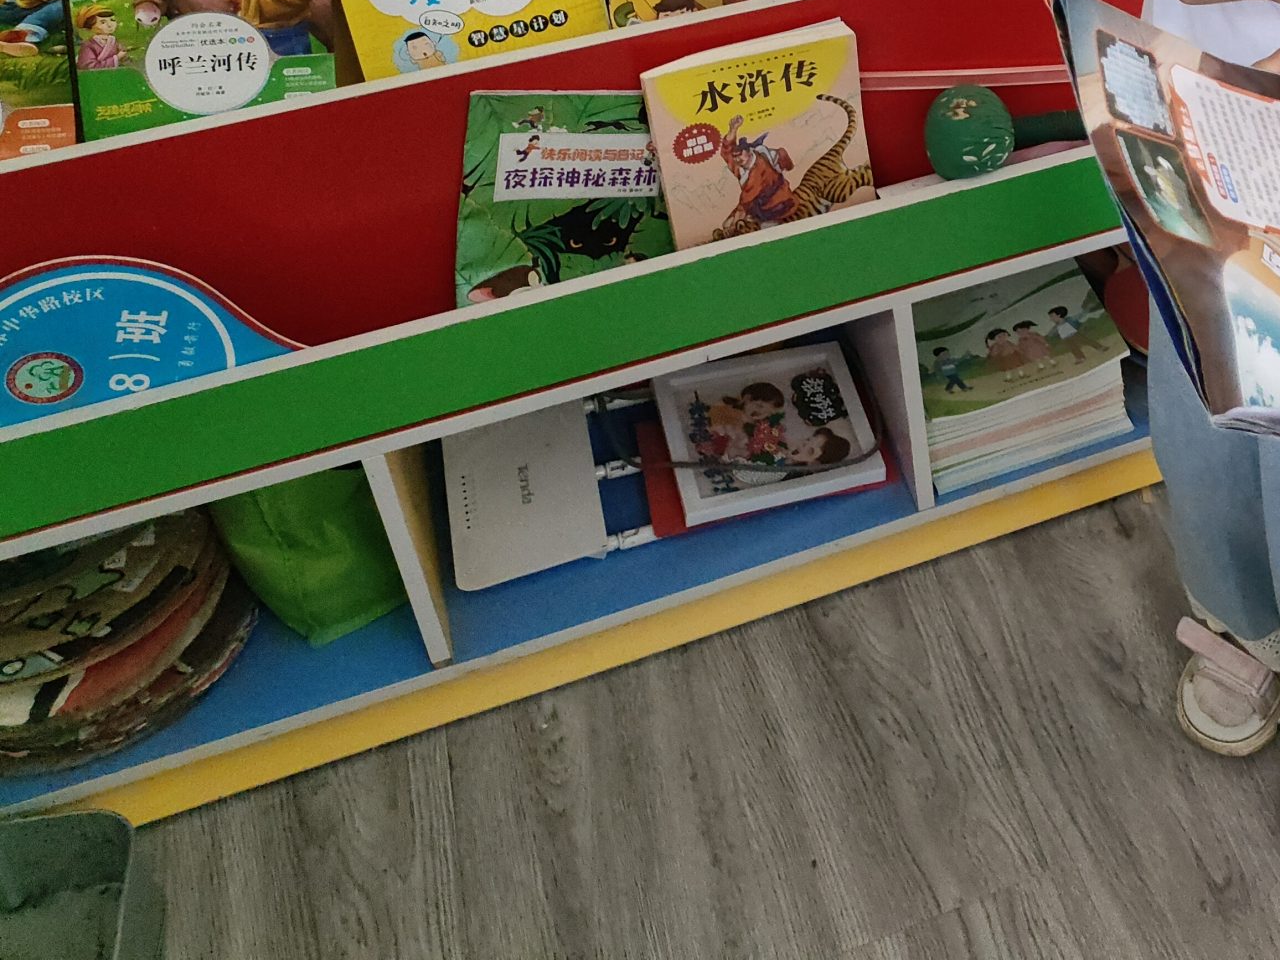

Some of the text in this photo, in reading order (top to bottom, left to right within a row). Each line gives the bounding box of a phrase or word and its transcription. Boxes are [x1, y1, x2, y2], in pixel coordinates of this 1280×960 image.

[424, 18, 461, 30] 自知之明
[469, 10, 568, 47] 智慧星计划
[159, 52, 258, 76] 呼兰河传
[694, 60, 817, 114] 水浒传
[541, 147, 645, 162] 快乐阅读与日记
[504, 167, 658, 189] 夜探神秘森林
[517, 463, 535, 504] Tenda
